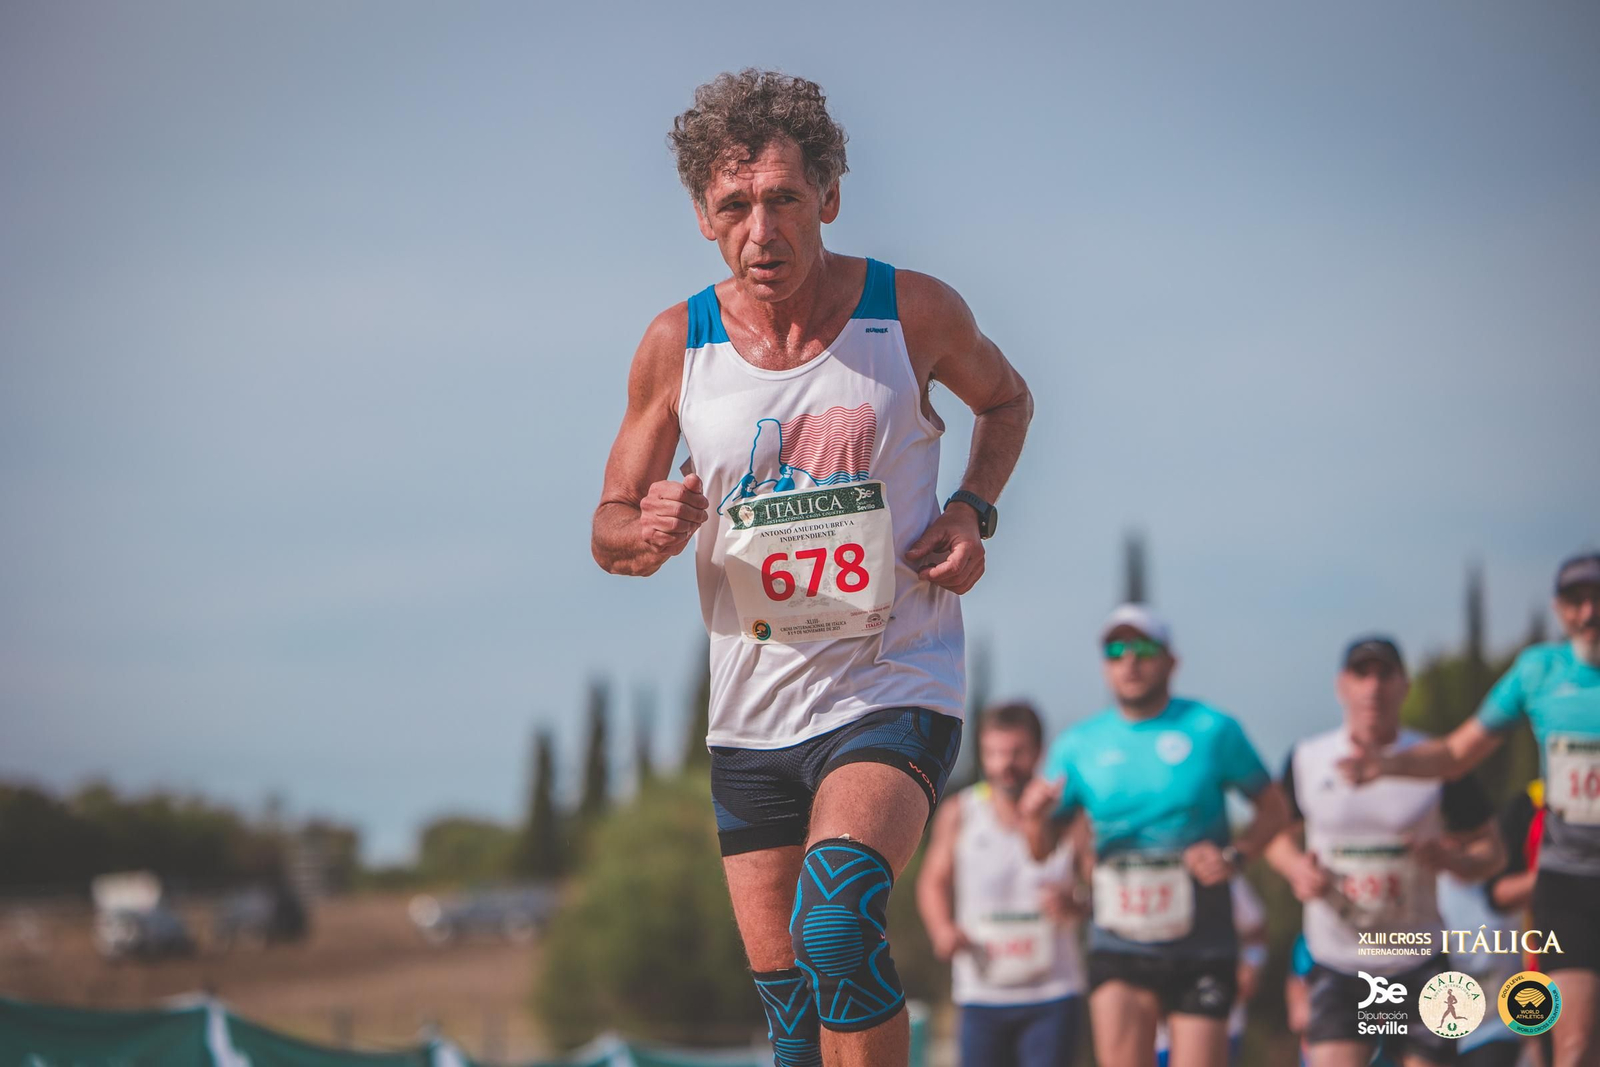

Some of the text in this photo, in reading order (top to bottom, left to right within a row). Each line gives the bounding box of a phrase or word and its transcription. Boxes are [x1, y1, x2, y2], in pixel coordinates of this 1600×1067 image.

[764, 494, 844, 520] ITÁLICA
[760, 519, 855, 538] ANTONIO AMUEDO UBREVA
[780, 530, 837, 543] INDEPENDIENTE
[761, 543, 870, 601] 678
